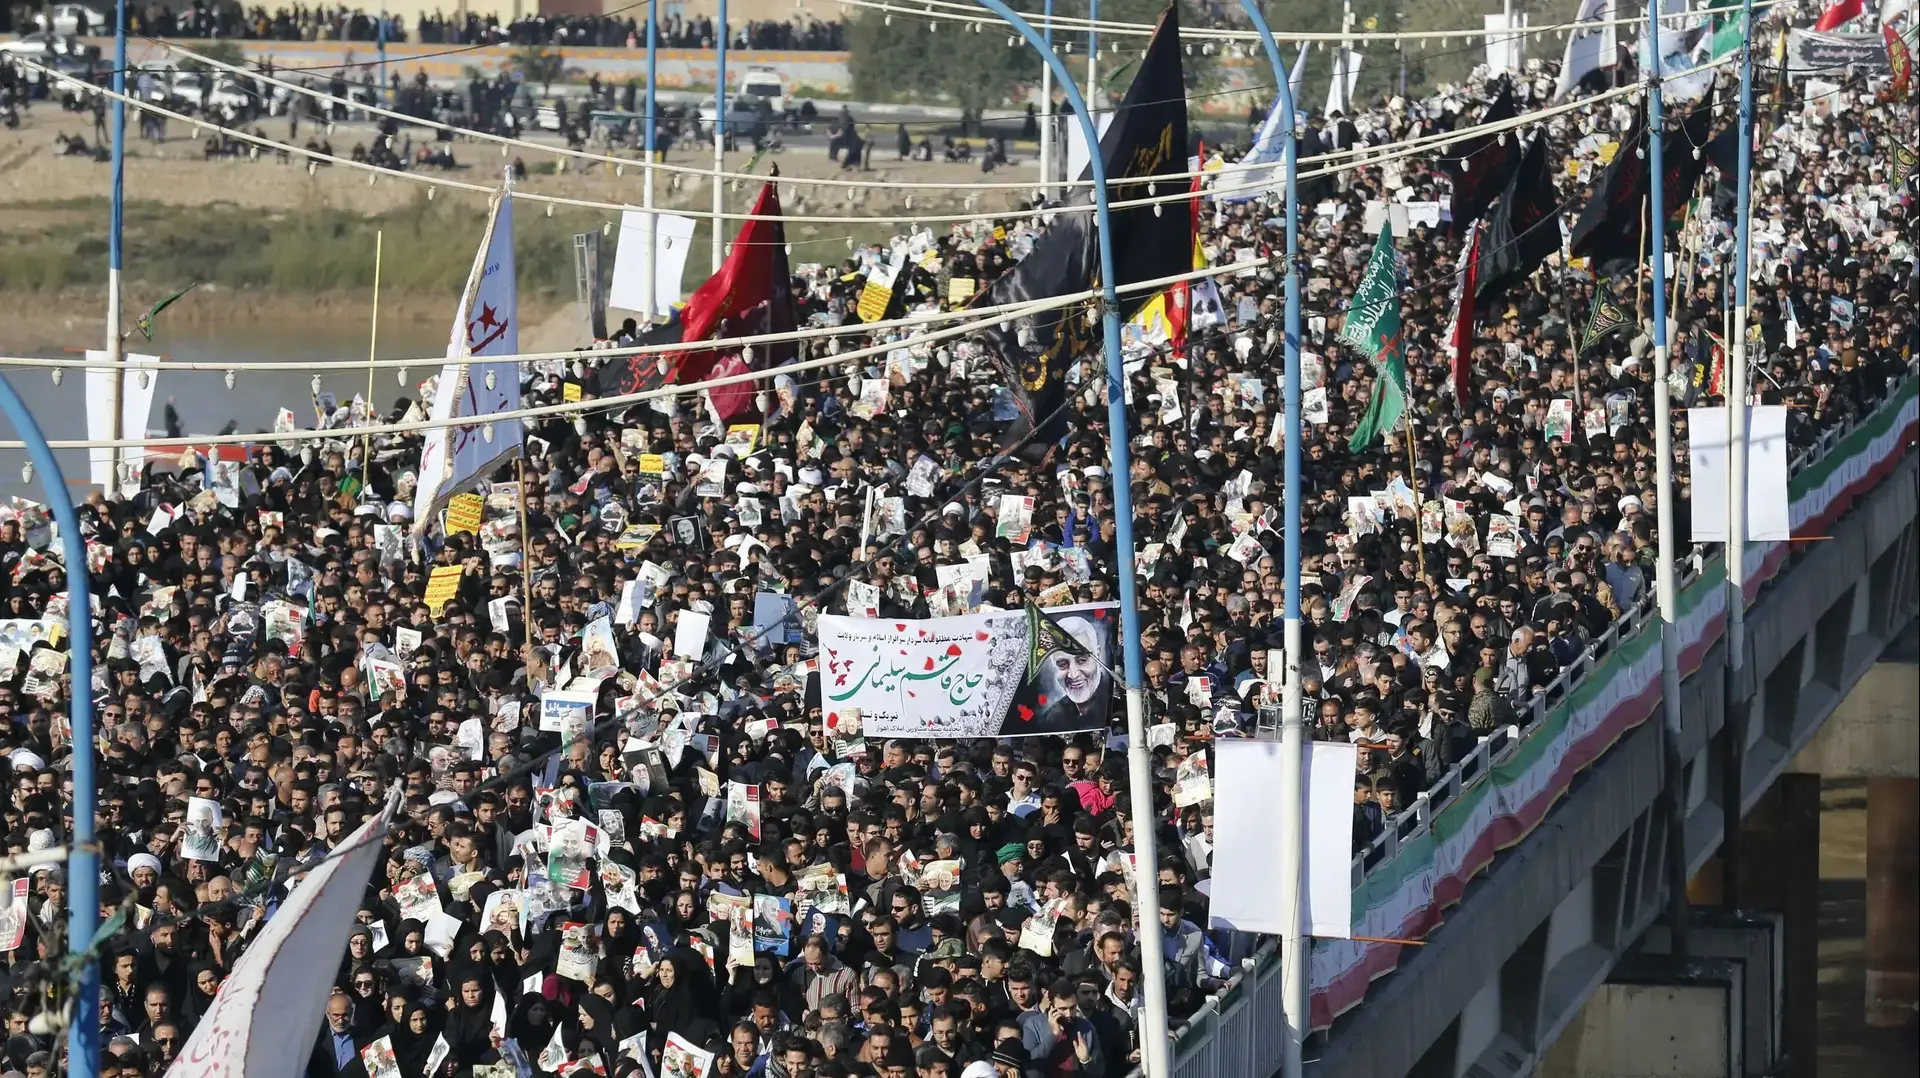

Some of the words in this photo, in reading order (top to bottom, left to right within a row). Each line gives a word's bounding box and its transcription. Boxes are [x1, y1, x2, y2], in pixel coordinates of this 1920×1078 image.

[951, 633, 973, 643] شهادت
[828, 644, 906, 701] سلیمانی
[900, 654, 960, 718] قاسم
[950, 671, 984, 706] حاج
[873, 713, 878, 721] و
[878, 711, 899, 722] تبریک
